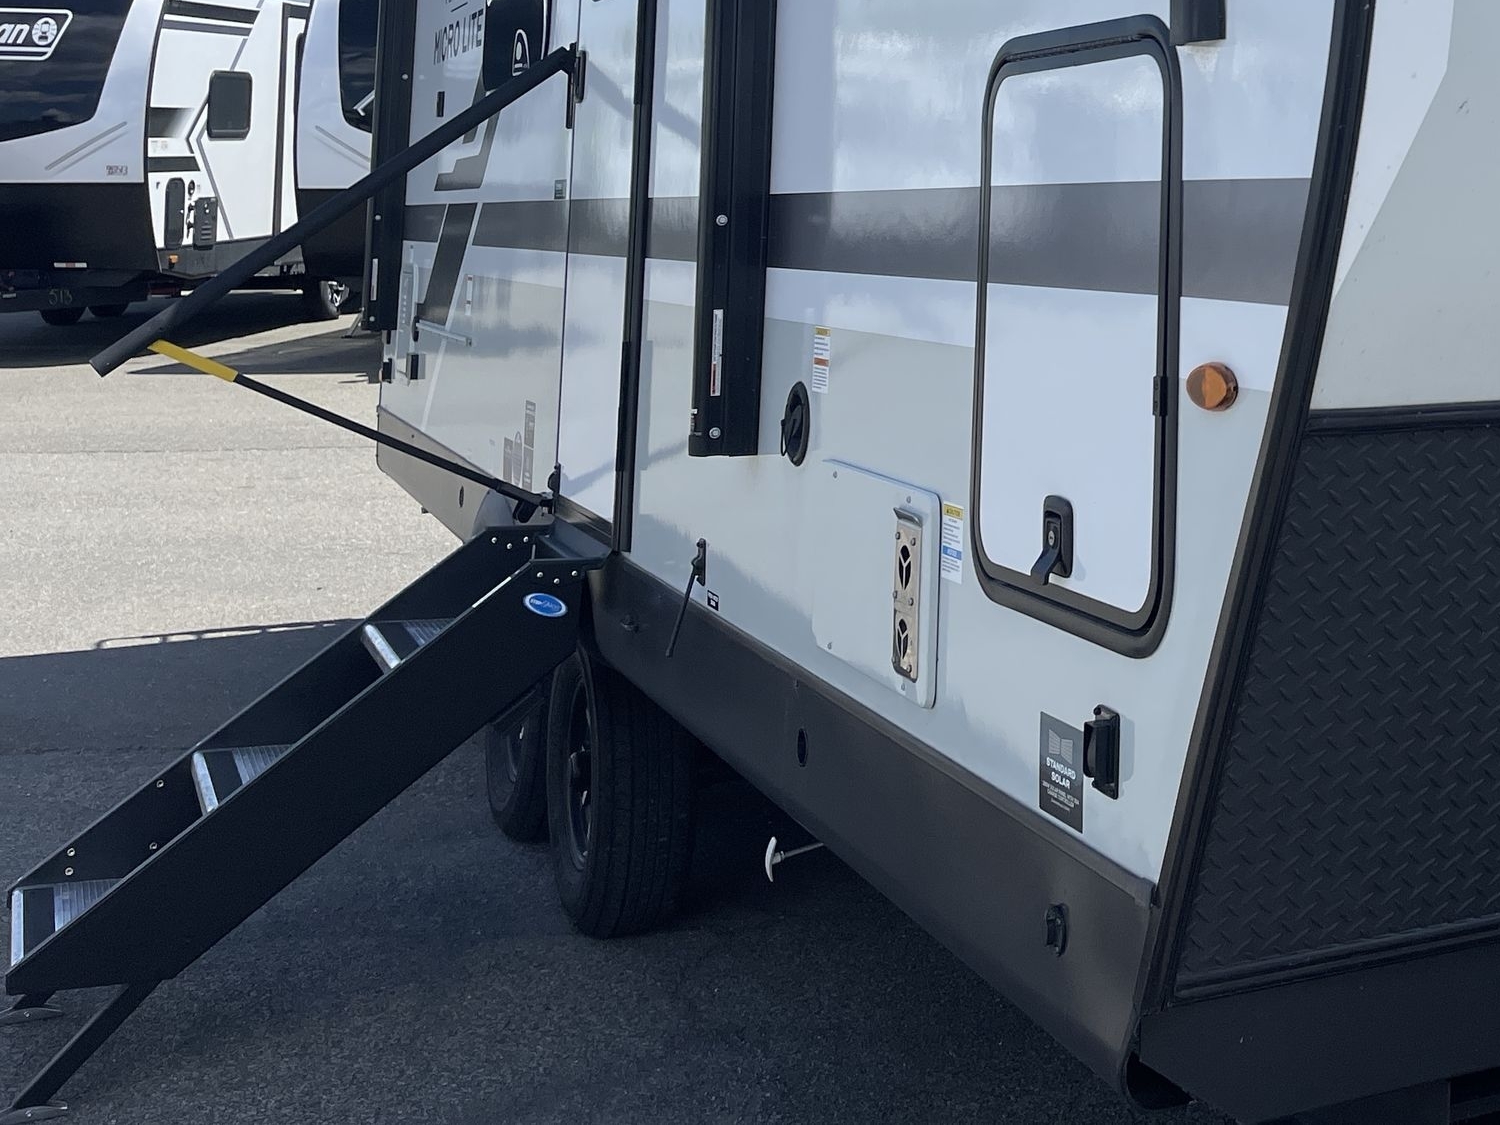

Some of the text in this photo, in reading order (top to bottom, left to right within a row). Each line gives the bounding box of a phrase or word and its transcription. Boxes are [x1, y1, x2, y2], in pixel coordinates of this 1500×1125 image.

[433, 9, 484, 66] MICRO LITE
[1046, 757, 1076, 780] STANDARD
[1051, 771, 1071, 789] SOLAR
